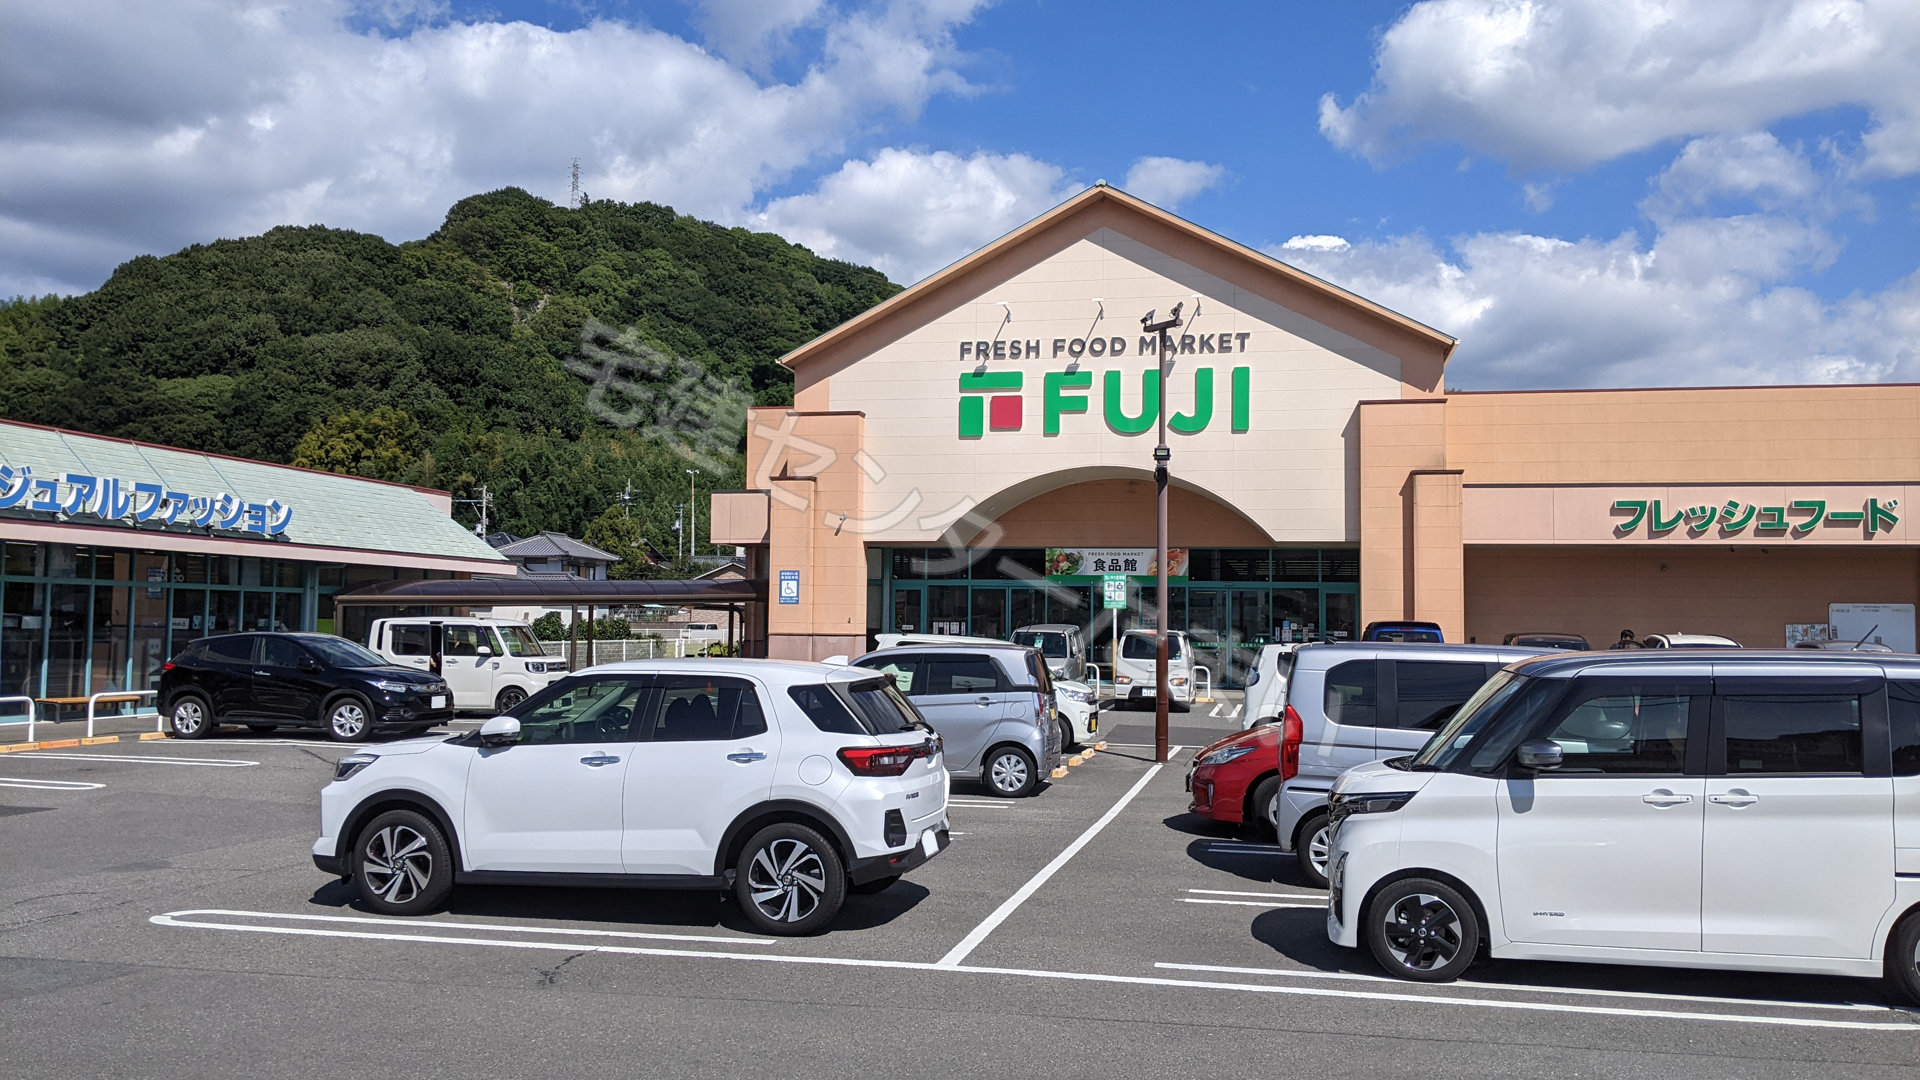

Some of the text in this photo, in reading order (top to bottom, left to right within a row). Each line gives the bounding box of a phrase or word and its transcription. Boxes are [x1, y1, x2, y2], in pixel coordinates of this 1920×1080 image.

[960, 333, 1250, 361] FRESH FOOD MARKET
[1043, 366, 1250, 437] FUJI
[1614, 498, 1900, 533] フレッシュフード
[1093, 558, 1137, 571] 食品館
